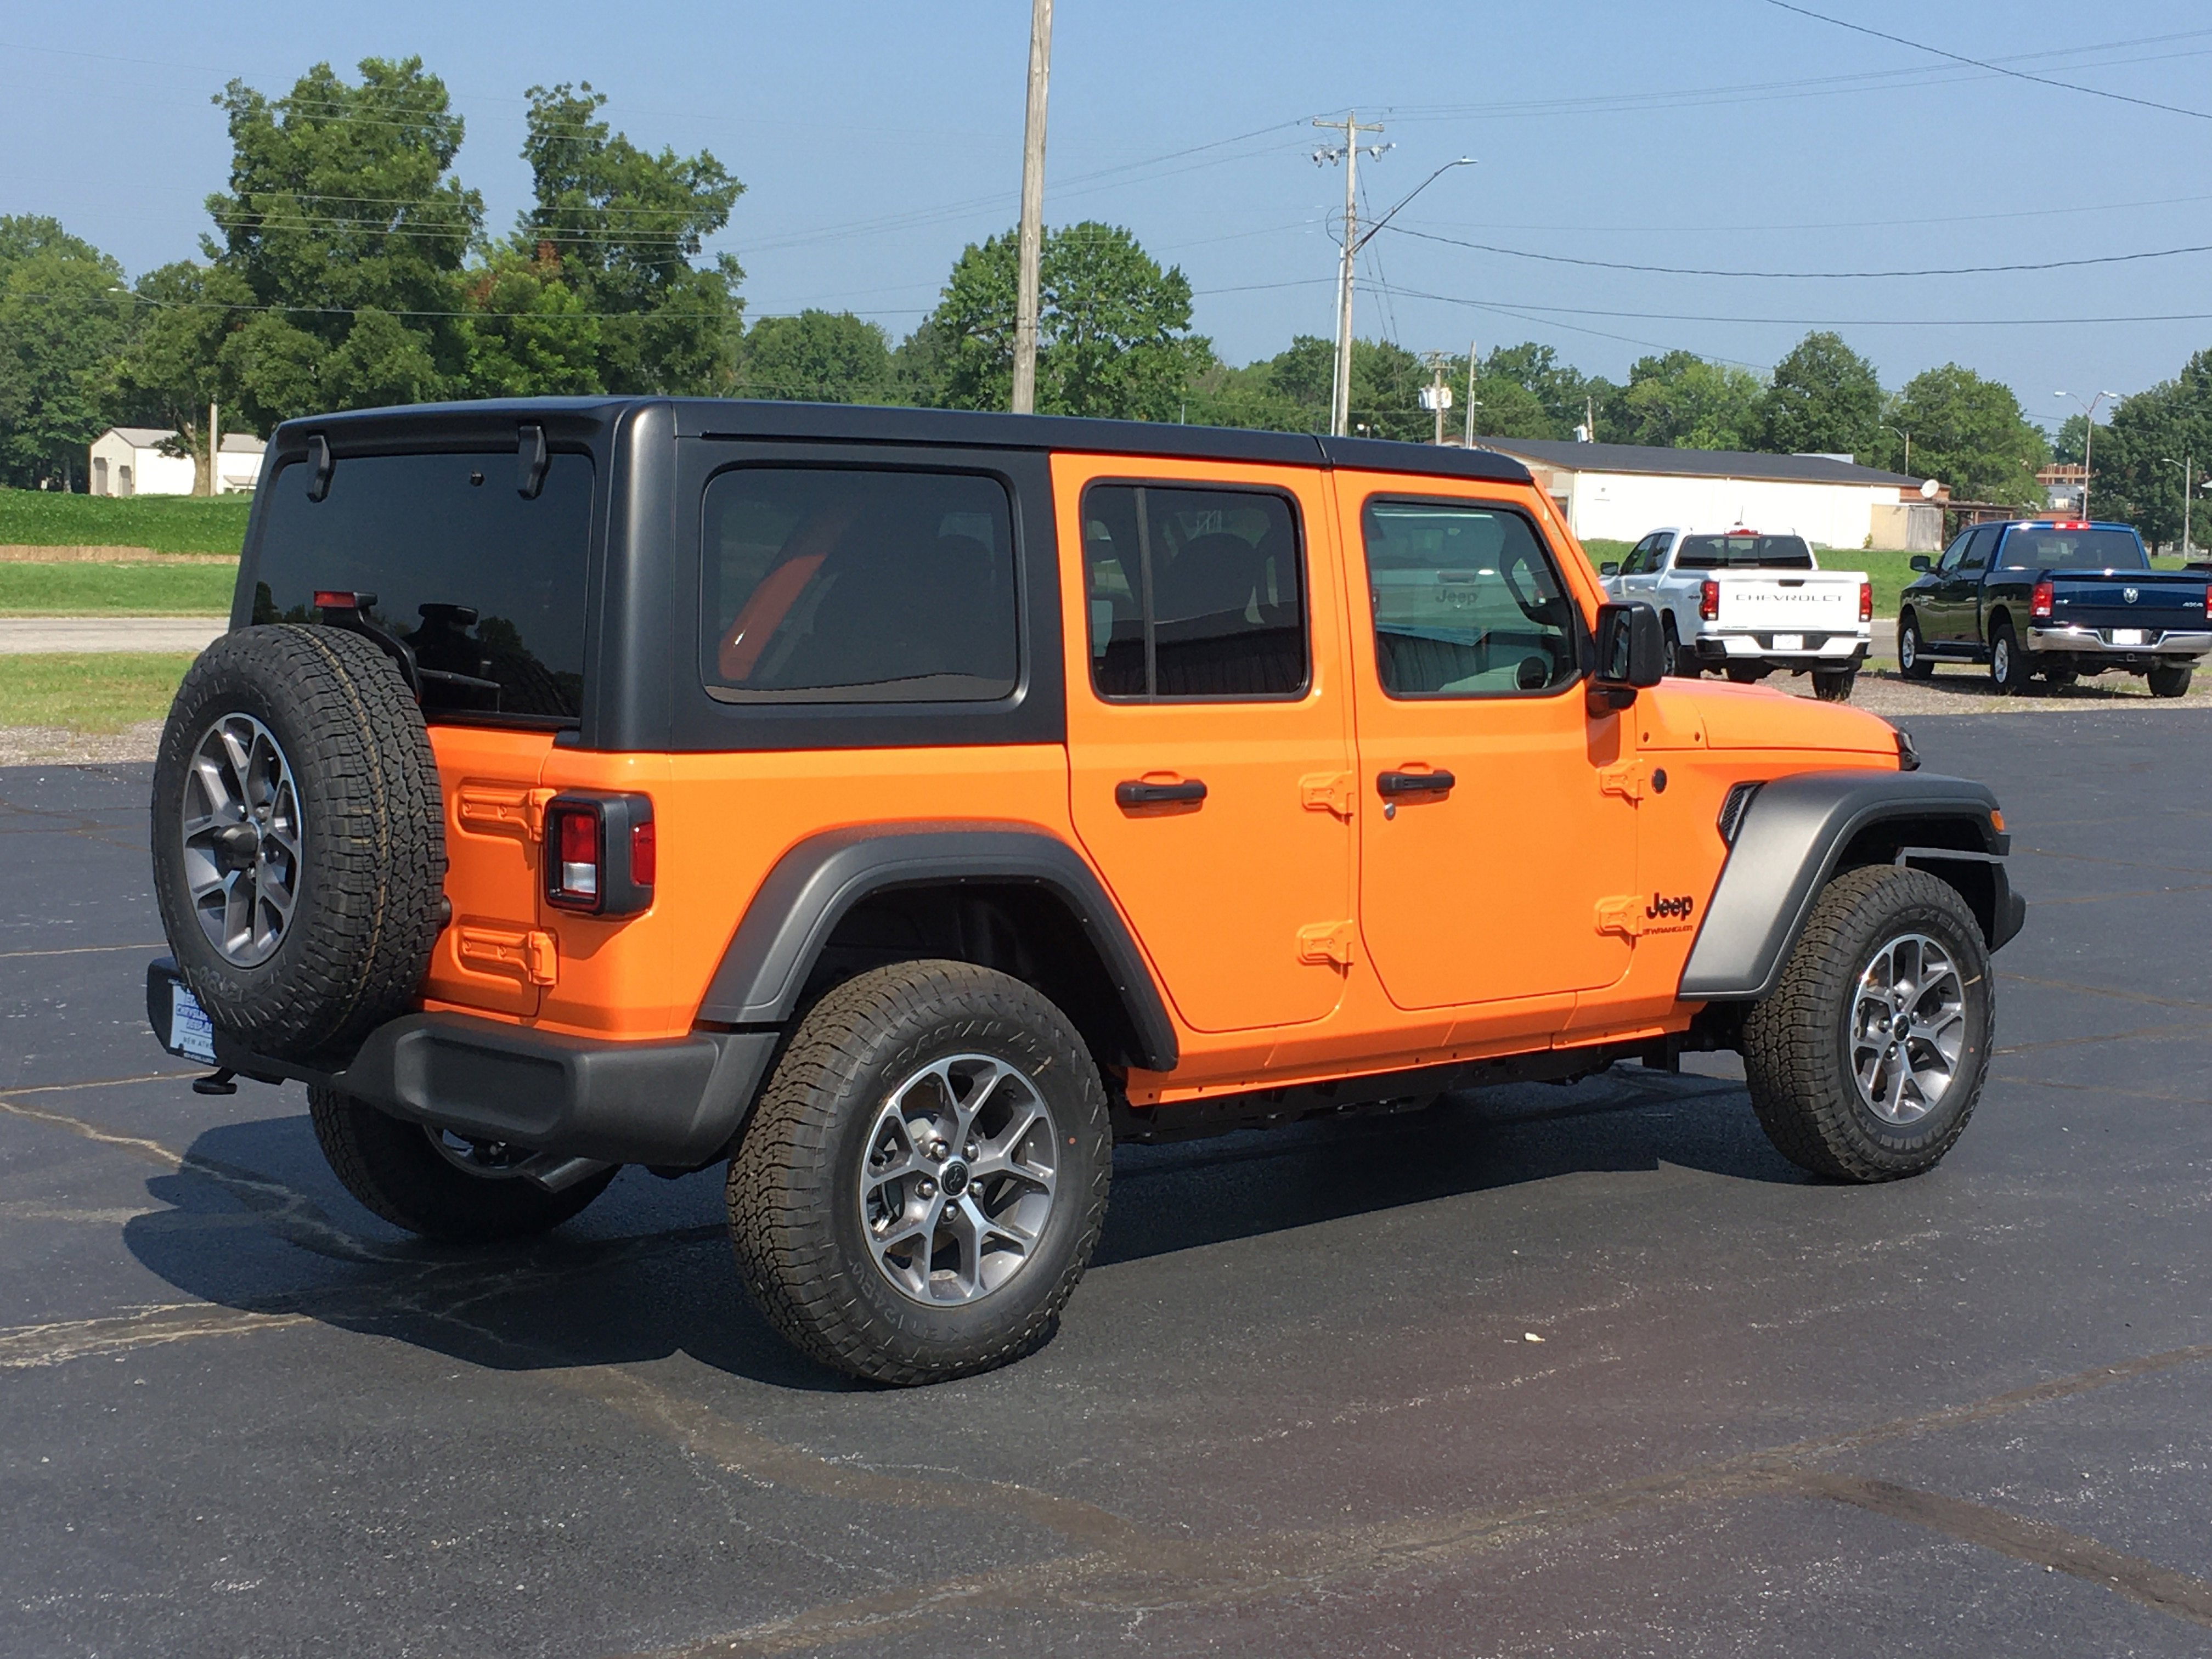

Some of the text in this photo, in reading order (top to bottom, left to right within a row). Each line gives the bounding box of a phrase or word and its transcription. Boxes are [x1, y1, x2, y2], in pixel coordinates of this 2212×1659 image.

[1435, 589, 1479, 605] Jeep
[1646, 892, 1693, 921] Jeep
[1650, 925, 1693, 935] WRANGLER
